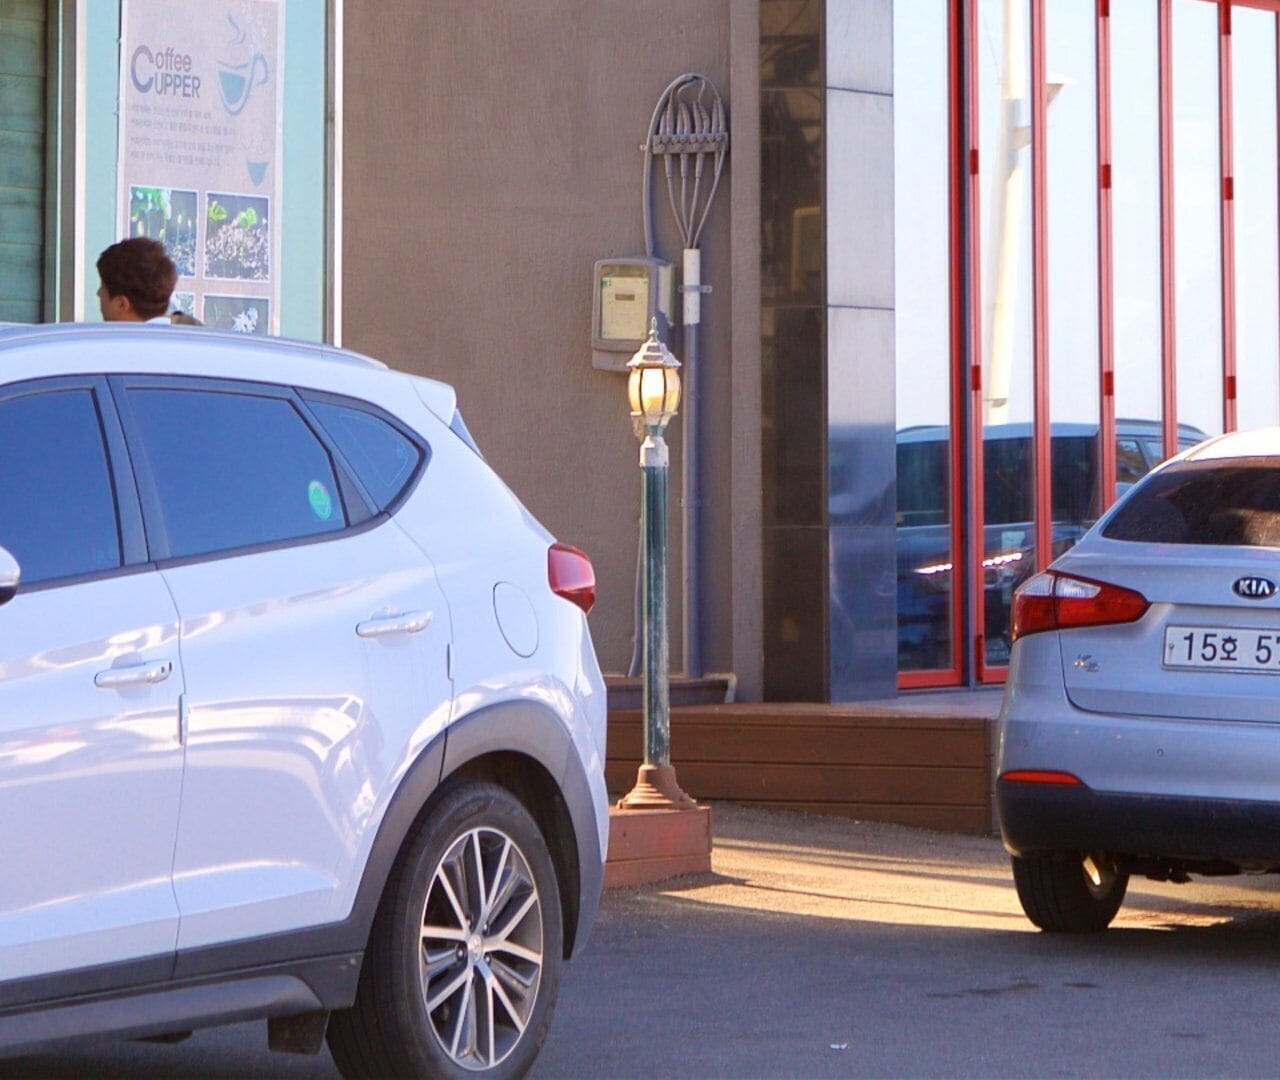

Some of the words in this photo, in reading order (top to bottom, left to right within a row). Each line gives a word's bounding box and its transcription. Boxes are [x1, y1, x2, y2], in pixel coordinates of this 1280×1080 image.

[130, 44, 192, 75] Coffee
[1238, 578, 1271, 597] KIA
[1181, 631, 1238, 663] 15호
